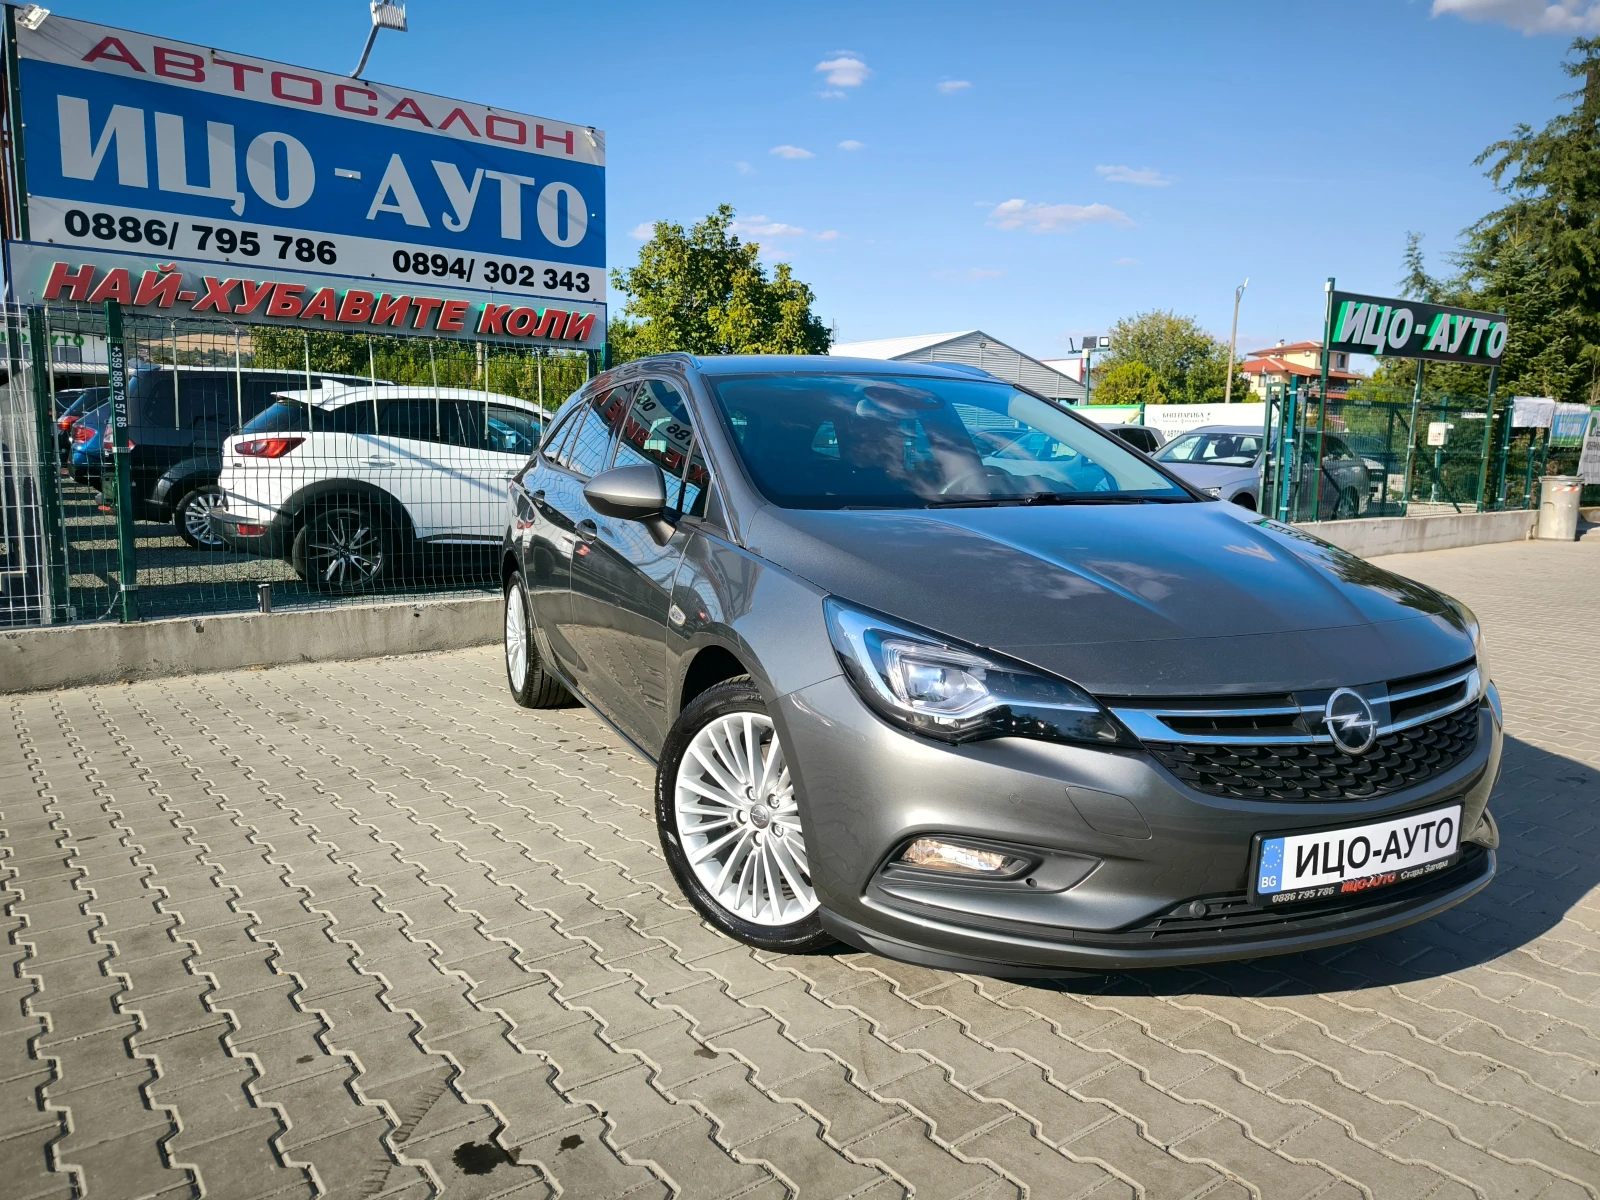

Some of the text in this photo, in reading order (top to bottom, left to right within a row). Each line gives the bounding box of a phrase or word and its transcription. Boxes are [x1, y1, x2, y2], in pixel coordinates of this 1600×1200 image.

[82, 36, 574, 155] АВТОСАЛОН
[64, 209, 337, 265] 0886/ 795 786
[392, 249, 591, 293] 0894/ 302 343
[43, 262, 597, 342] НАЙ-ХУБАВИТЕ КОЛИ
[1338, 301, 1508, 359] ИЦО-АУТО
[112, 346, 127, 428] +359 886 79 57 86
[1295, 817, 1454, 878] ИЦО-АУТО
[1261, 875, 1277, 888] BG
[1272, 892, 1296, 903] 0886
[1298, 889, 1316, 900] 795
[1317, 886, 1335, 897] 786
